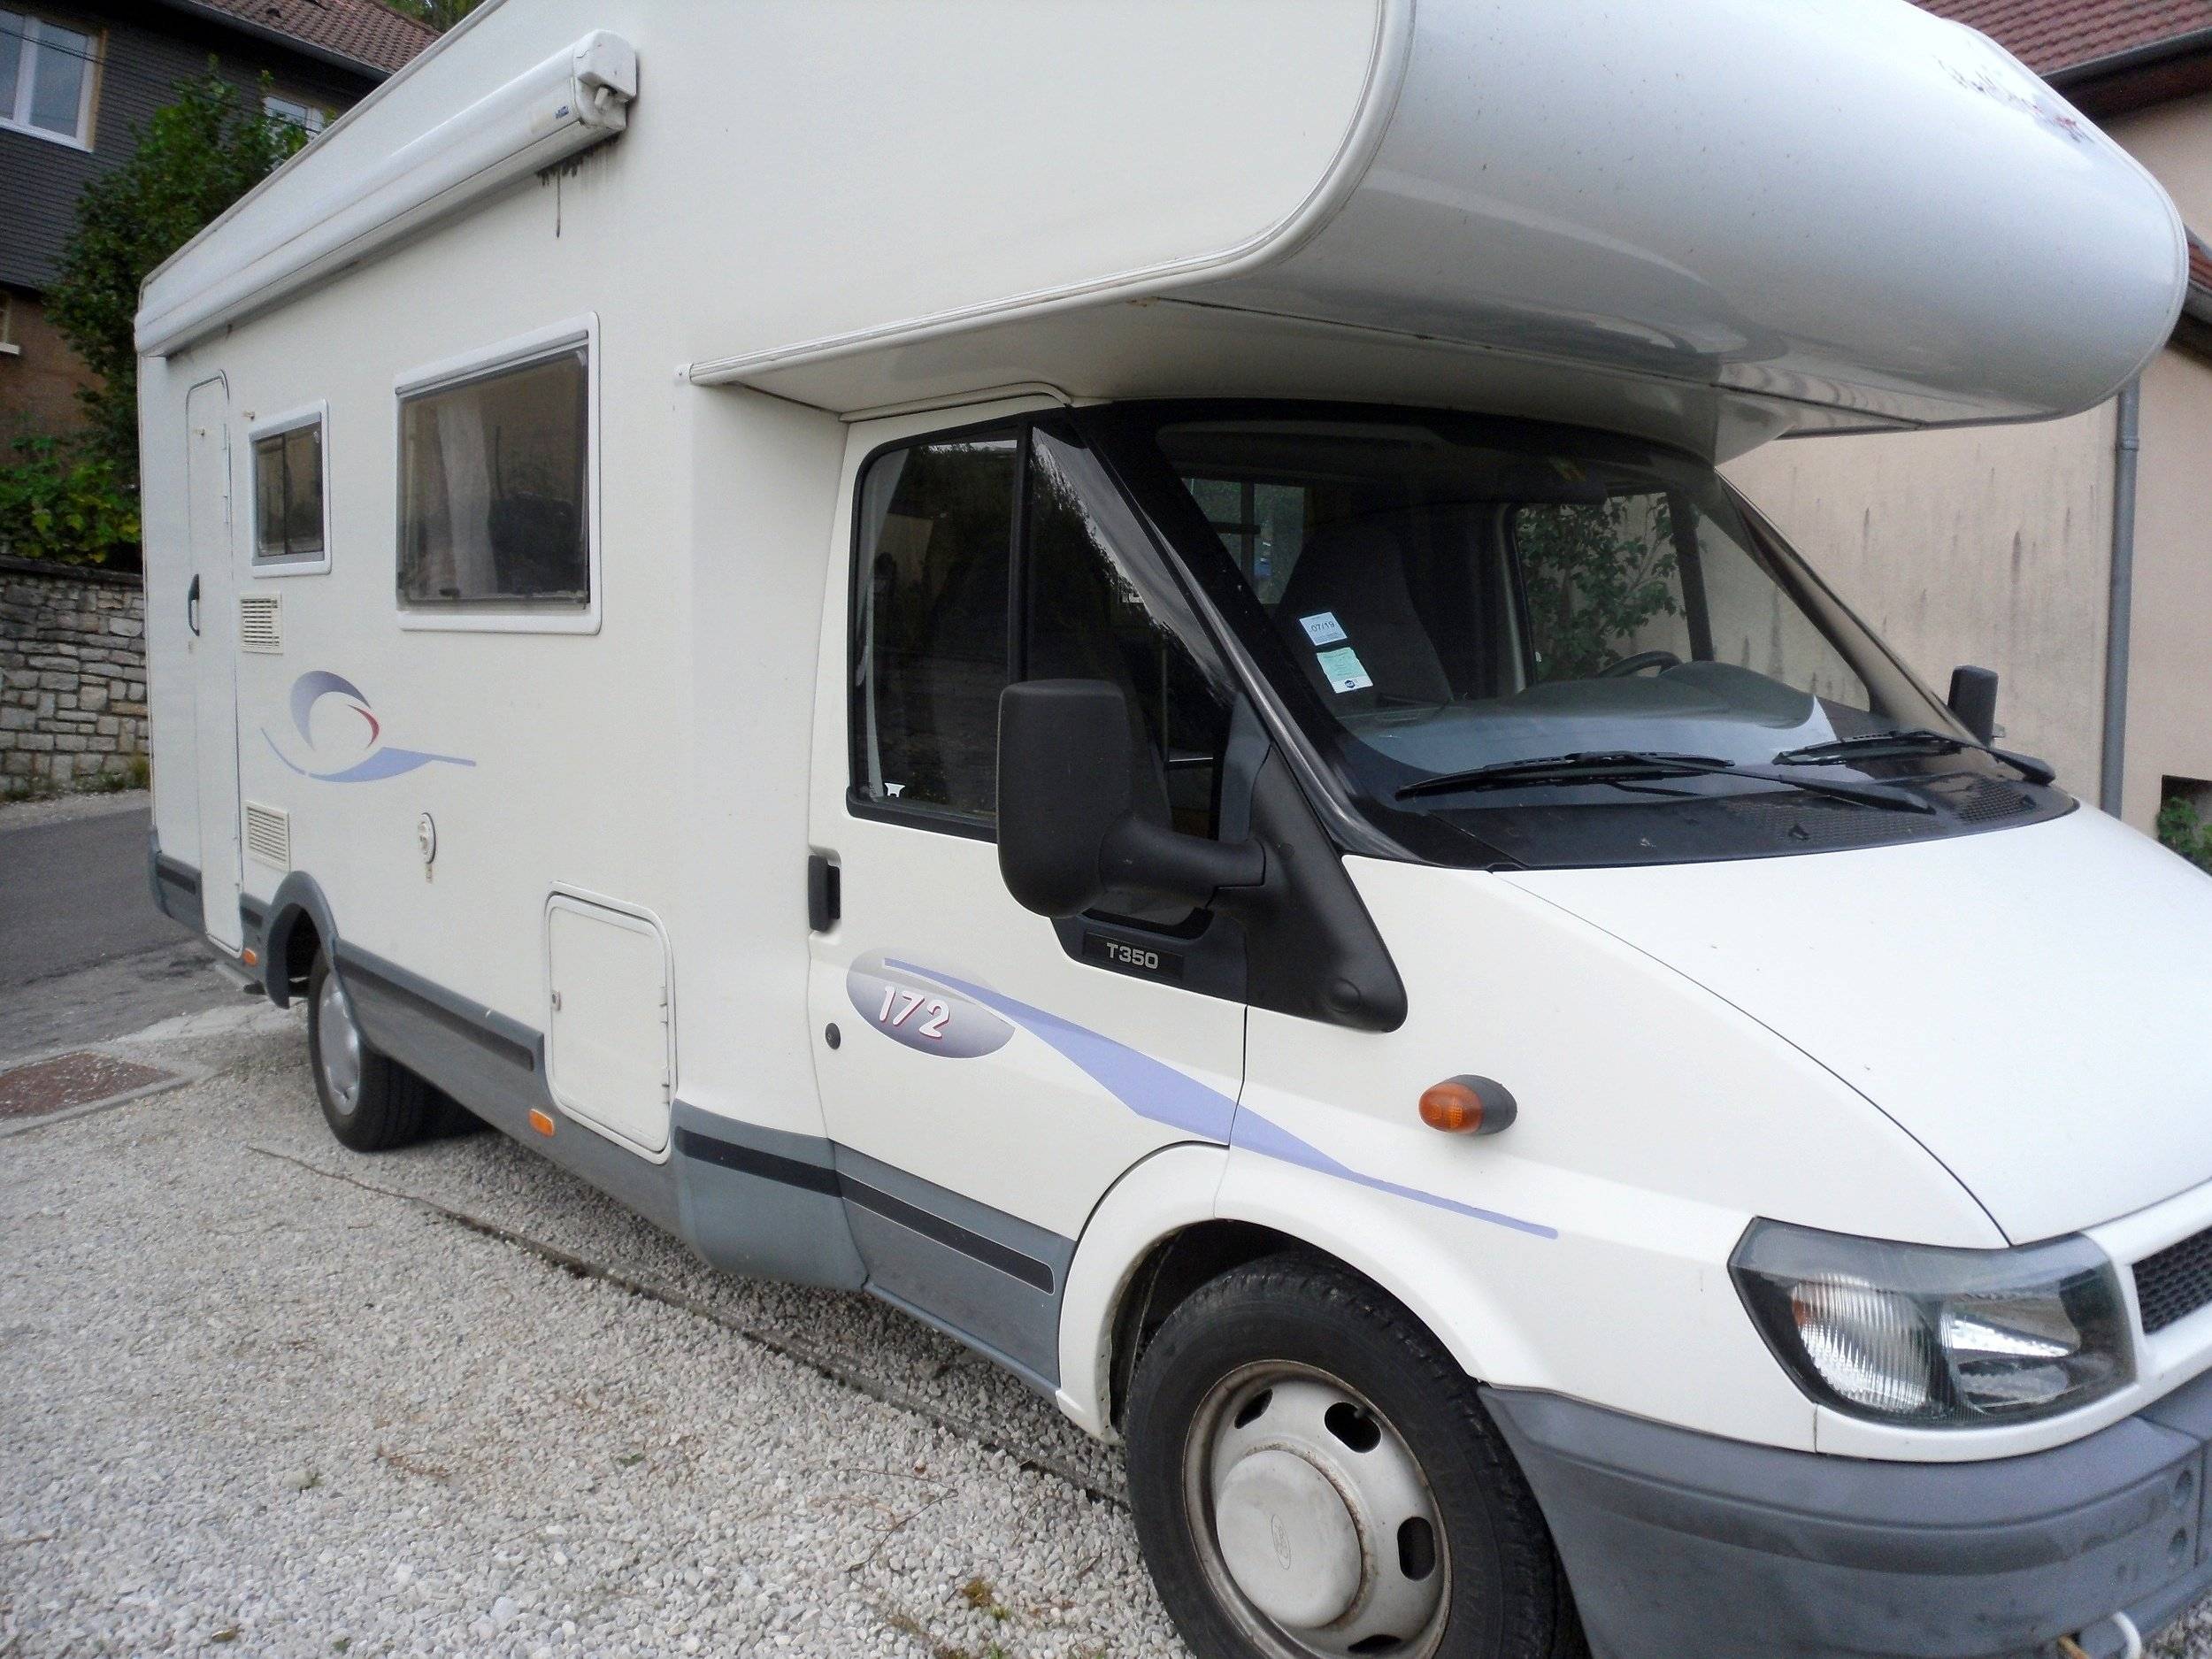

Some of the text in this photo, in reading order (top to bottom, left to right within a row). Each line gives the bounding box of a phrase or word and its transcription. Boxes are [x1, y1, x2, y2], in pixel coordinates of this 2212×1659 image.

[1310, 621, 1335, 633] 07/19
[1106, 942, 1159, 970] T350
[879, 985, 950, 1039] 172
